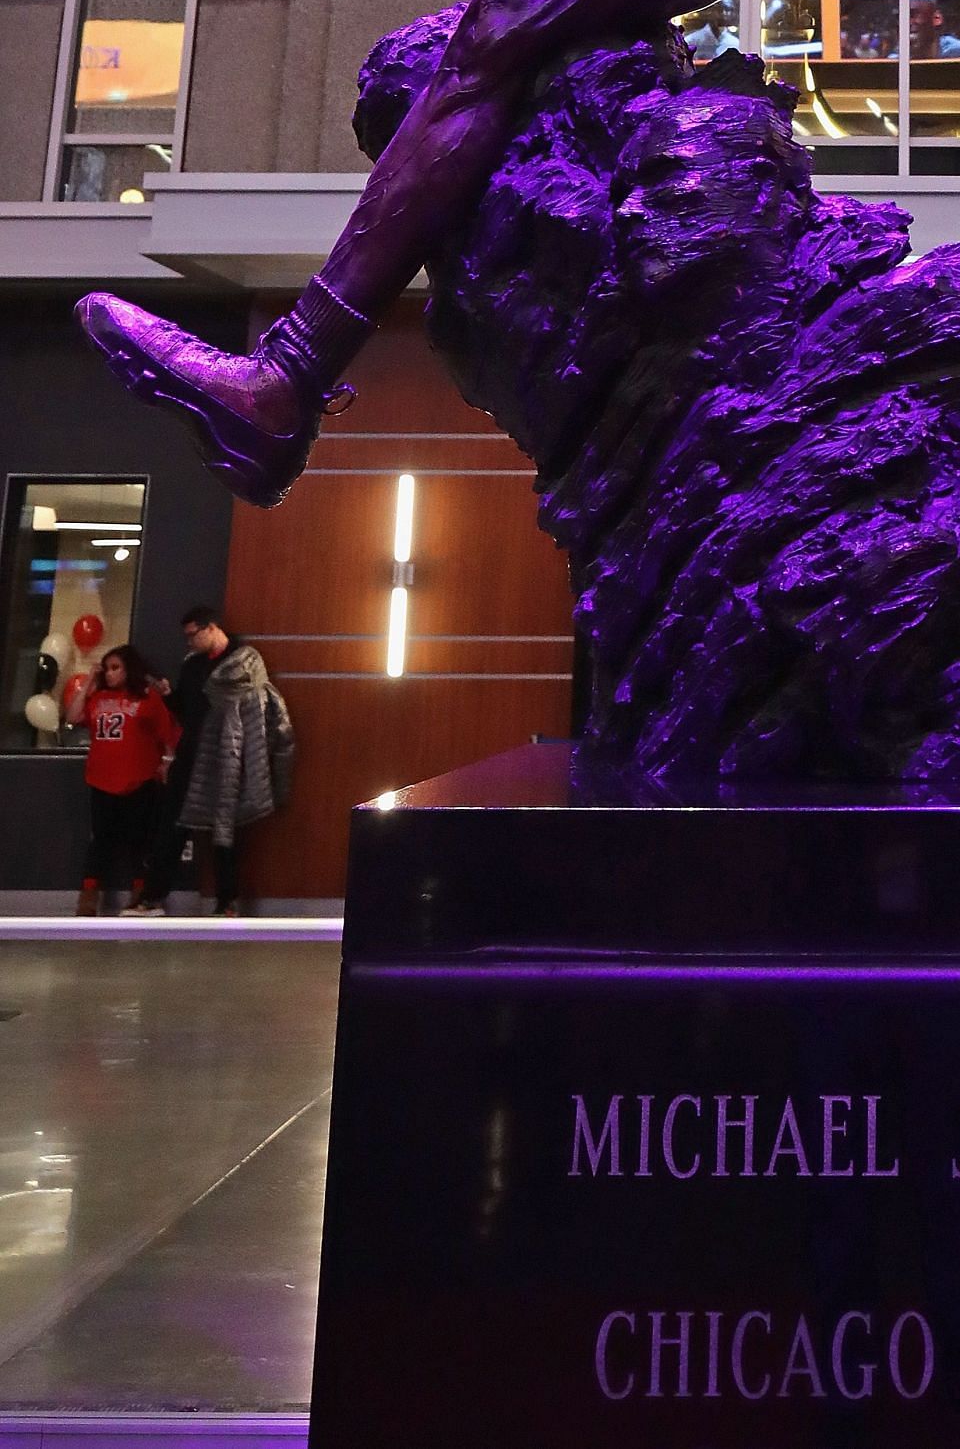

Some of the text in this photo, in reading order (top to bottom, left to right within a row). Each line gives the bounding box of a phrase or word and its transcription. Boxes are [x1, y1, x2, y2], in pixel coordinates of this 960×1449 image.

[95, 712, 125, 741] 12
[568, 1094, 900, 1179] MICHAEL
[595, 1310, 935, 1400] CHICAGO
